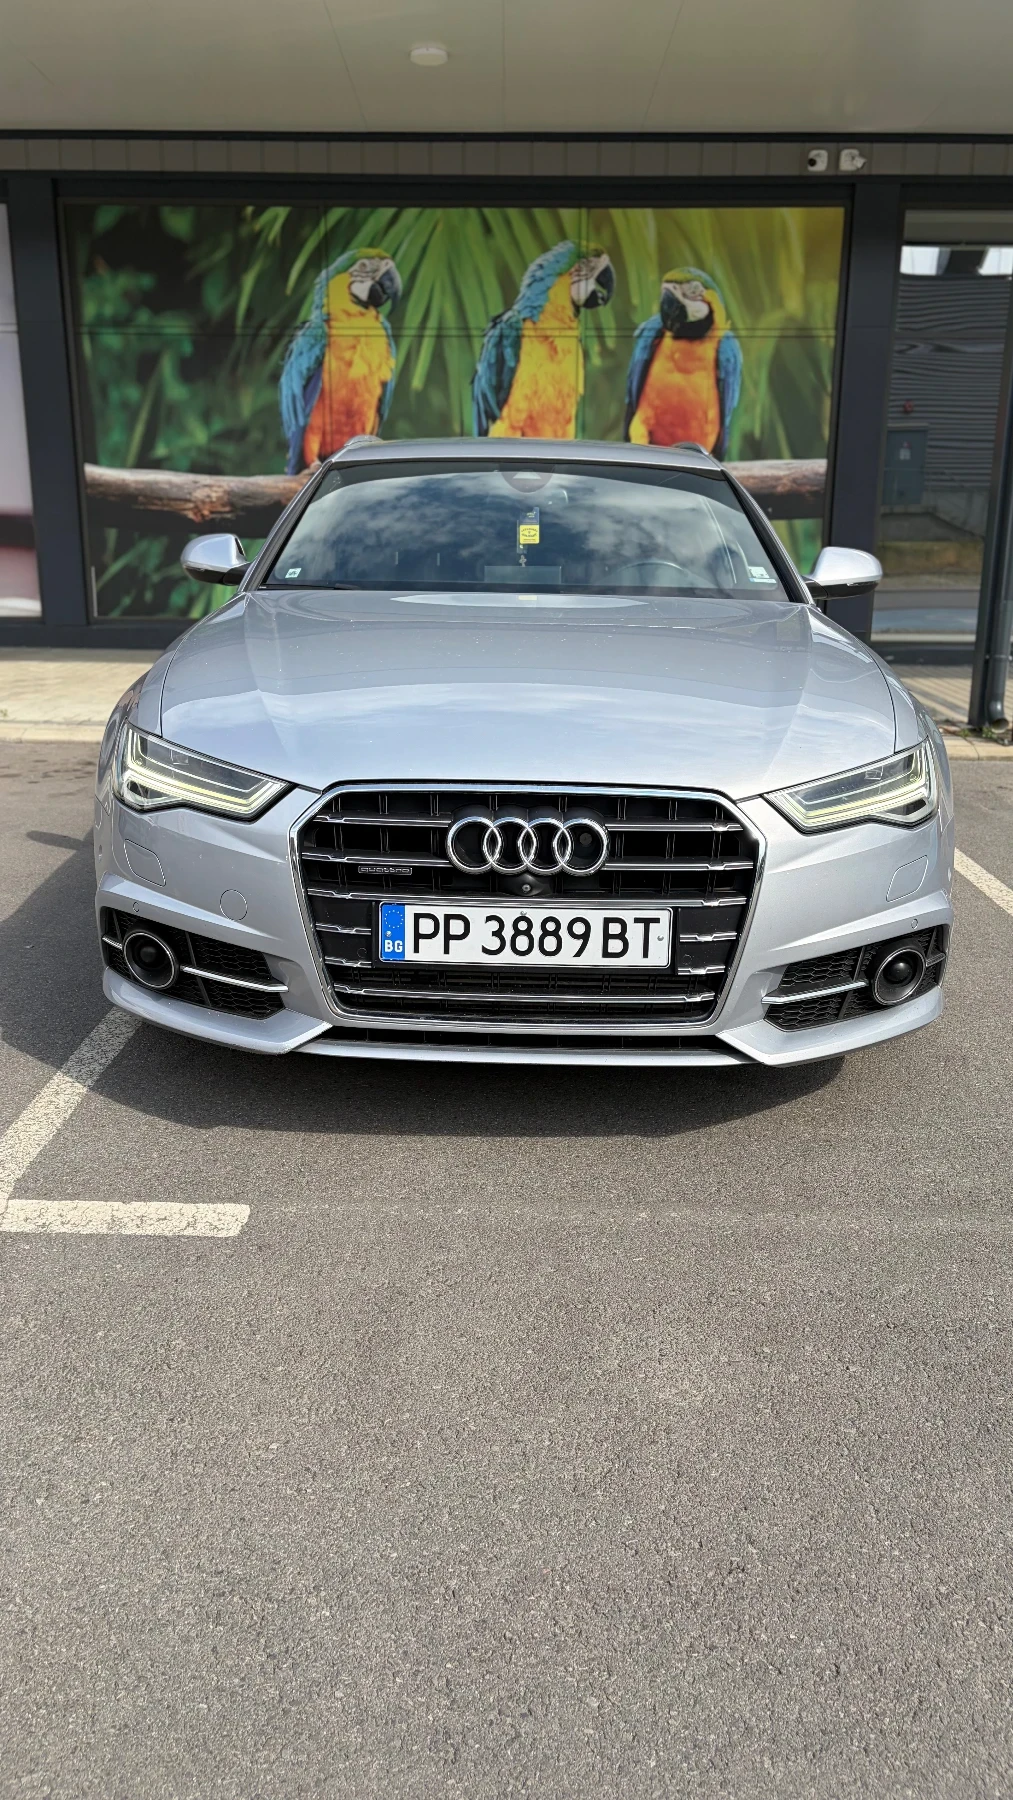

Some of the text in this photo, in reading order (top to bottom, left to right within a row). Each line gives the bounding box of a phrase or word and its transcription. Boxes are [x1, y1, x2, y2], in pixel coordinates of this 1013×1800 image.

[384, 940, 403, 953] BG
[413, 912, 661, 960] PP 3889 BT
